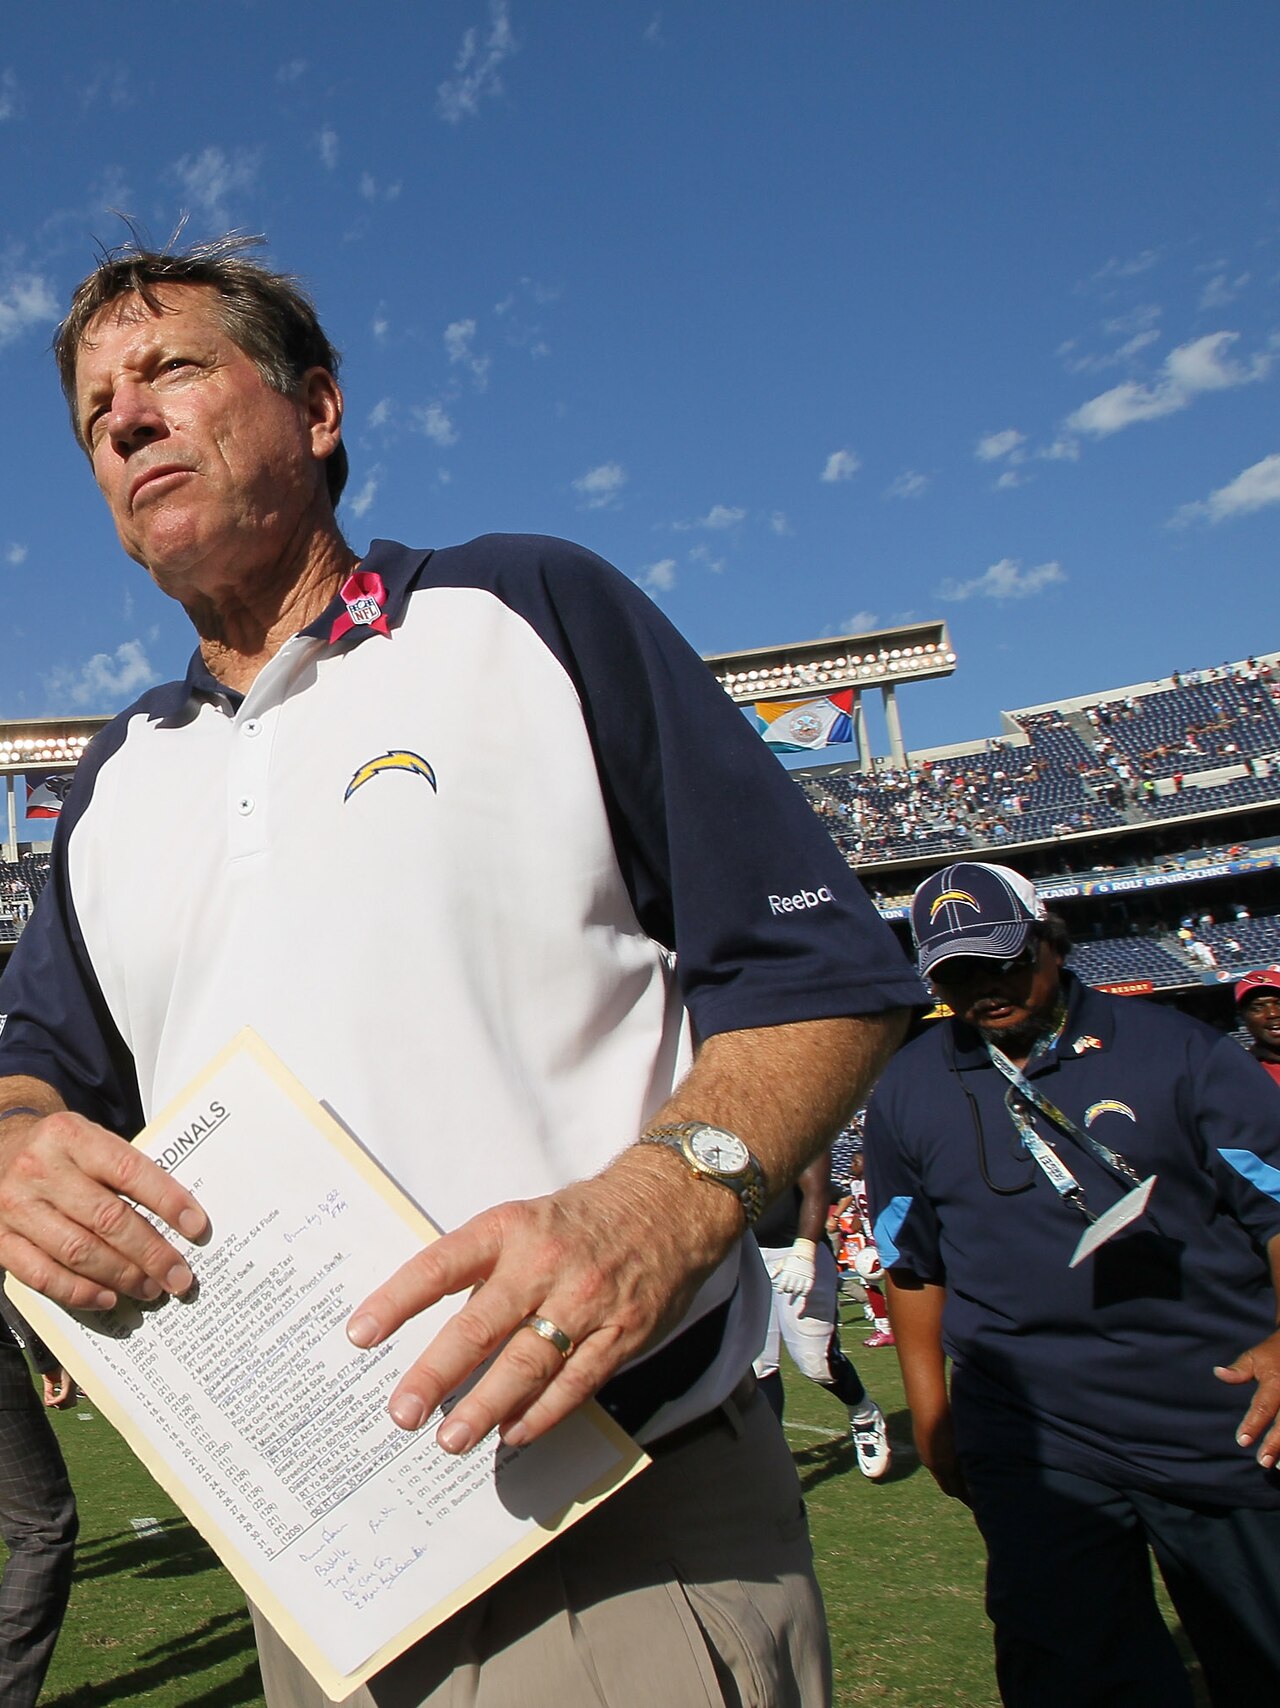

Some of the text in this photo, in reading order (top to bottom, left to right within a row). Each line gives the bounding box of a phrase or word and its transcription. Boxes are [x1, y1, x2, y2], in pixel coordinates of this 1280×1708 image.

[355, 605, 378, 622] NFL
[768, 884, 836, 916] Reebo
[1112, 879, 1144, 892] ROLF
[1145, 866, 1231, 886] BENIRSCHKE
[878, 909, 904, 920] TON
[155, 1101, 226, 1173] RDINALS
[193, 1177, 203, 1190] RT
[162, 1317, 180, 1335] Blast
[180, 1306, 191, 1317] LT
[207, 1274, 227, 1291] Truck
[170, 1340, 187, 1356] Dixie
[185, 1330, 195, 1342] LT
[193, 1315, 214, 1333] Home
[219, 1288, 242, 1309] Bubble
[182, 1315, 198, 1330] Scat
[195, 1299, 215, 1318] Spray
[218, 1283, 233, 1297] Fish
[186, 1357, 197, 1369] RT
[196, 1342, 215, 1360] Close
[223, 1323, 236, 1336] Act
[275, 1266, 296, 1286] Bullet
[189, 1340, 201, 1351] RT
[199, 1325, 219, 1343] Nasty
[217, 1313, 232, 1327] Gun
[235, 1276, 272, 1310] Boomerang
[276, 1254, 293, 1269] Taxi
[210, 1383, 231, 1404] Diesel
[230, 1370, 247, 1386] Orbit
[245, 1358, 261, 1372] Ride
[259, 1344, 277, 1360] Pass
[287, 1311, 312, 1336] (Stutter
[310, 1294, 332, 1313] Pass)
[329, 1283, 344, 1296] Fox
[231, 1415, 248, 1428] Pop
[244, 1400, 261, 1416] Gold
[258, 1394, 270, 1404] De
[268, 1377, 288, 1395] Home
[295, 1358, 310, 1372] Bob
[238, 1423, 254, 1436] Flex
[251, 1411, 267, 1424] Gun
[264, 1400, 280, 1413] Key
[306, 1360, 325, 1376] Drag
[255, 1422, 270, 1435] Gun
[308, 1374, 326, 1389] Stab
[274, 1457, 296, 1477] Diesel
[293, 1447, 308, 1460] Fox
[331, 1410, 351, 1428] Short
[361, 1386, 380, 1402] Stop
[384, 1368, 400, 1382] Flat
